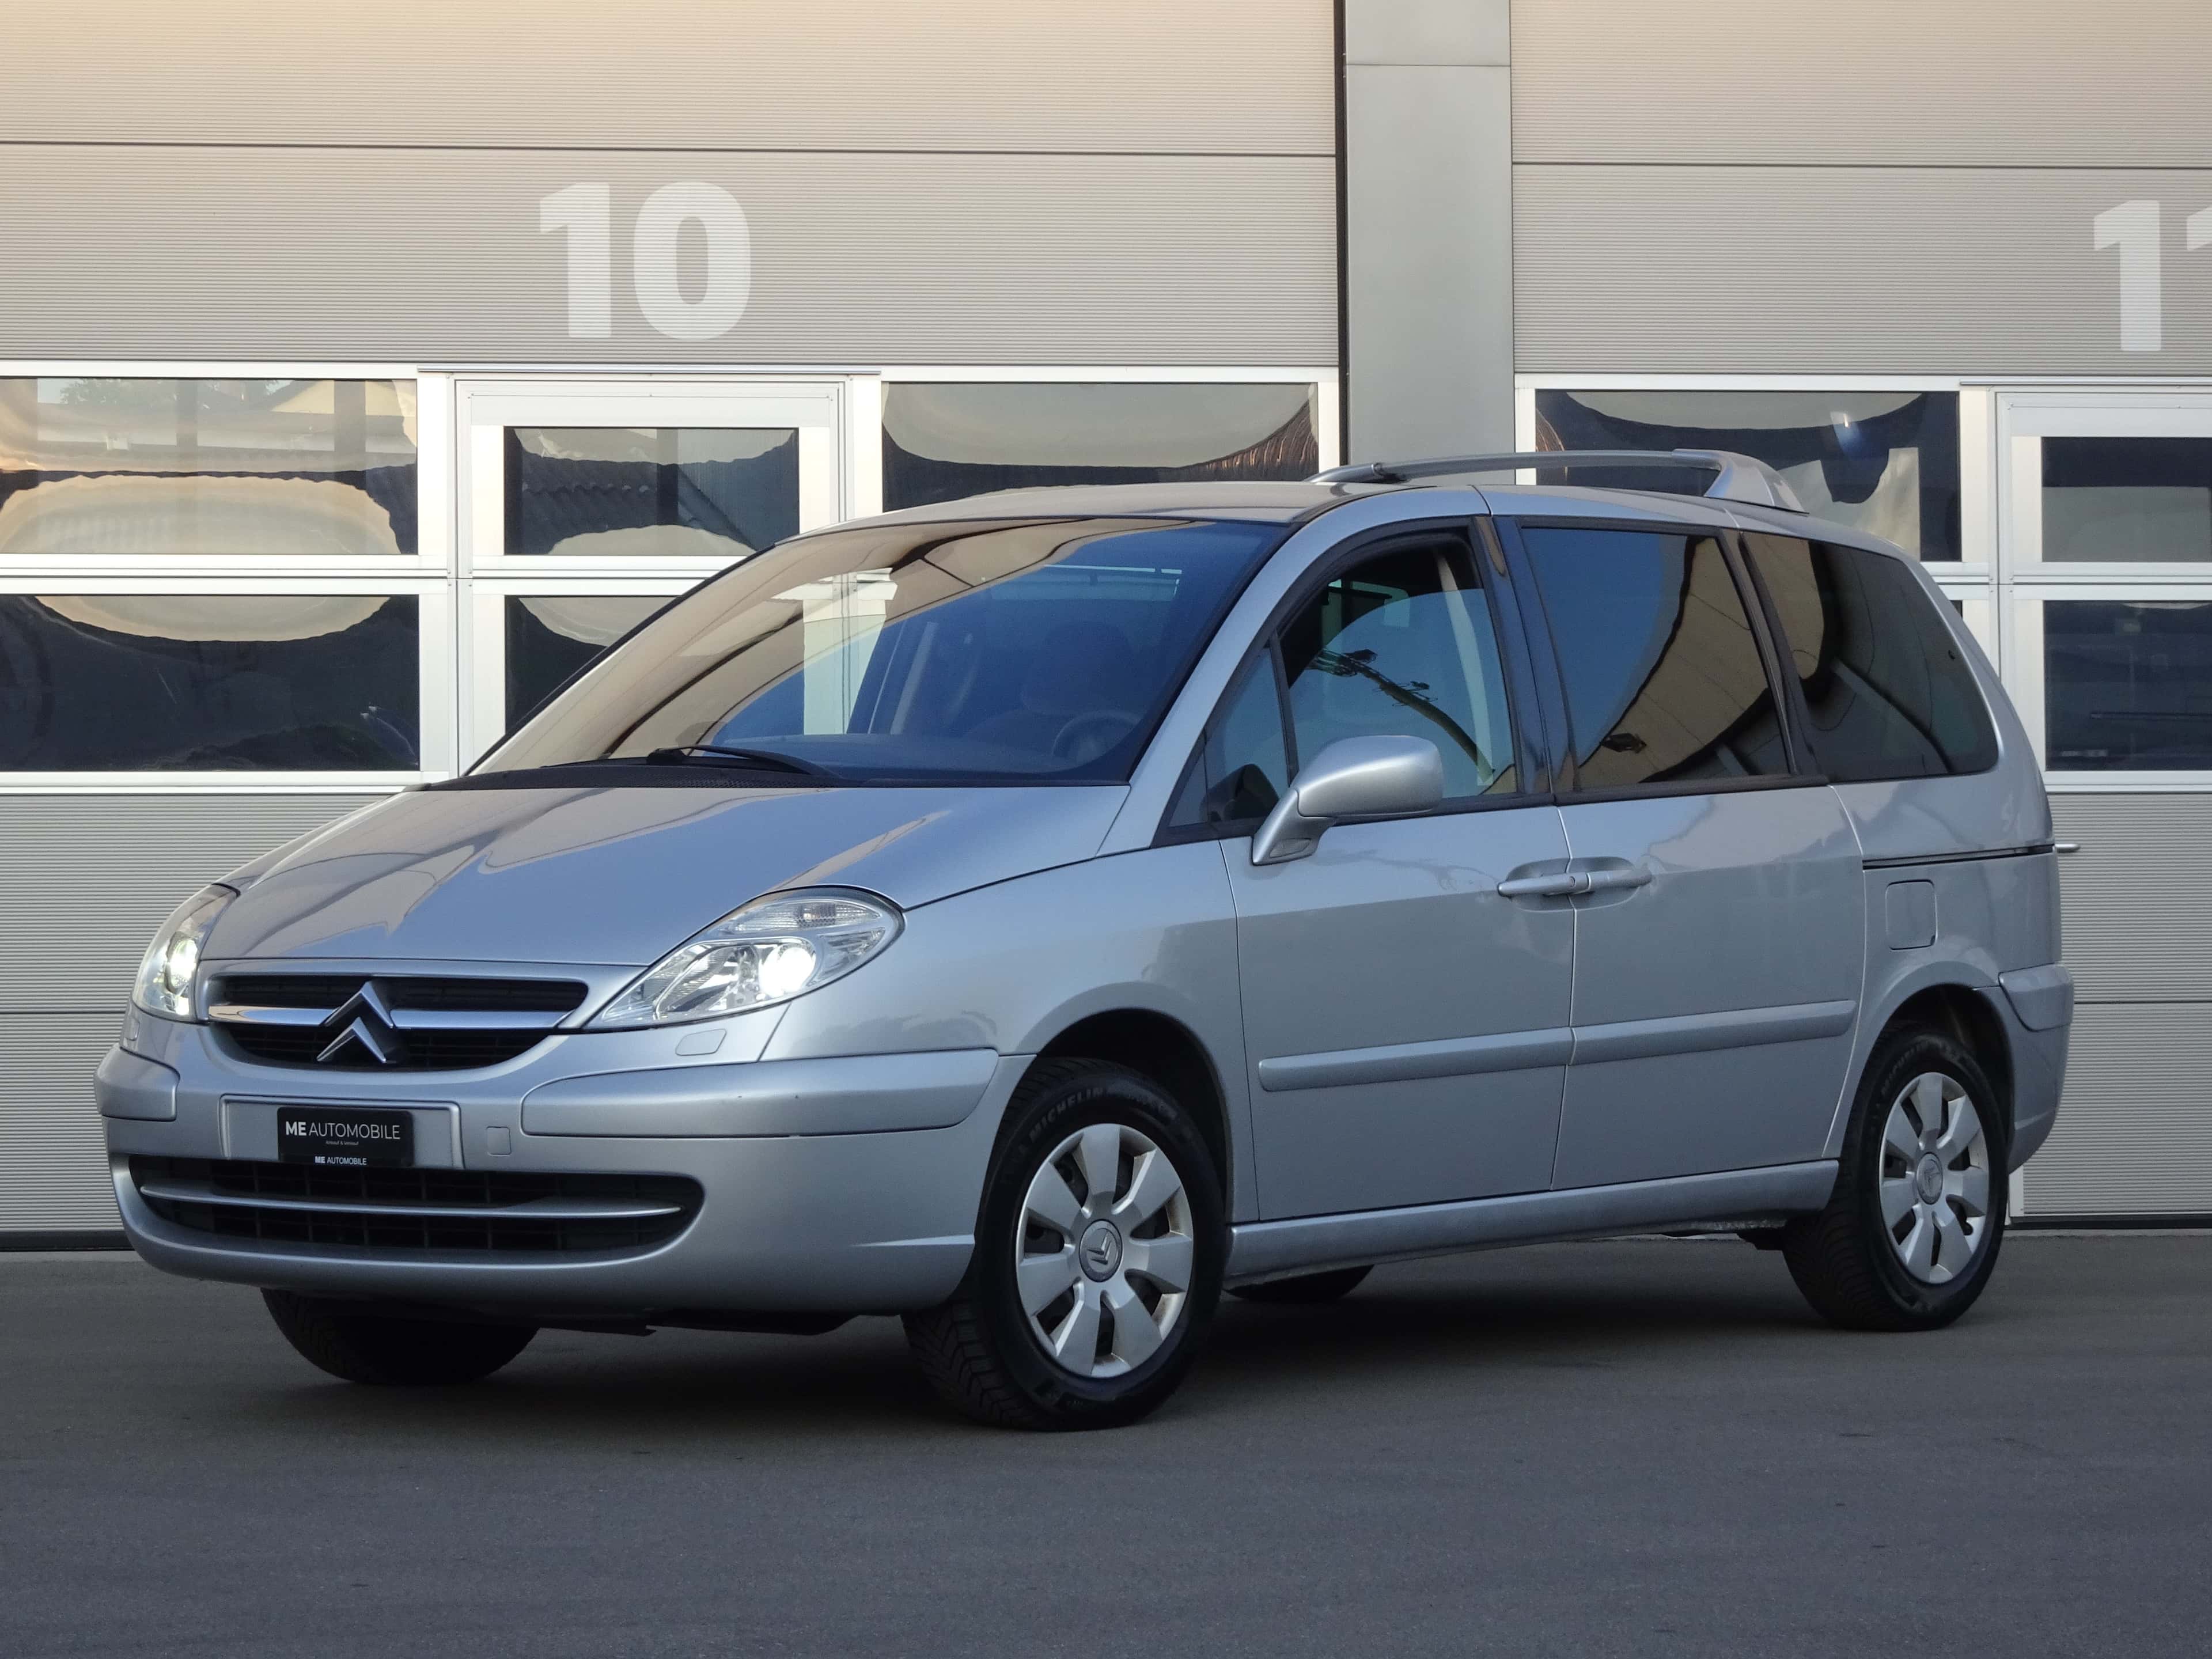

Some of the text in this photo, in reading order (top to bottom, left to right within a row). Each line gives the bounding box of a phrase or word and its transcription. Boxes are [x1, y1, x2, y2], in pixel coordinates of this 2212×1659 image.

[539, 181, 751, 341] 10
[2093, 199, 2212, 351] 1
[285, 1121, 401, 1140] ME AUTOMOBILE
[315, 1156, 368, 1165] ME AUTOMOBILE
